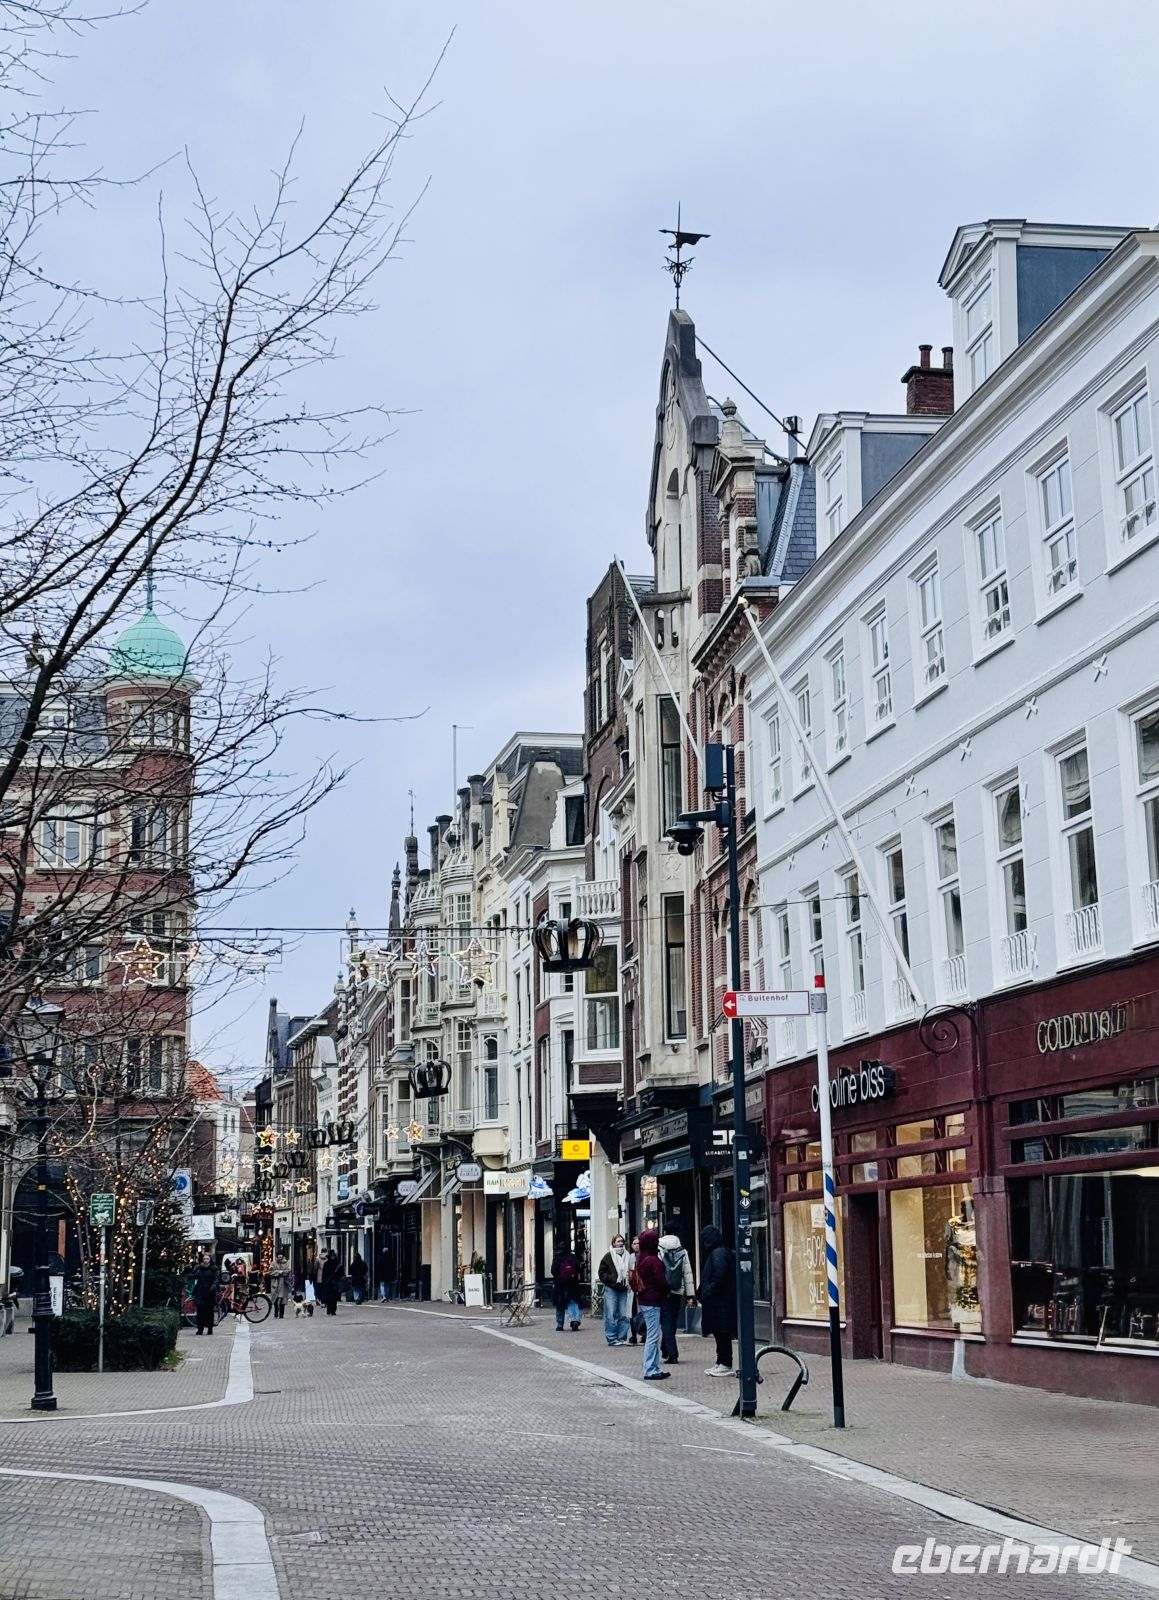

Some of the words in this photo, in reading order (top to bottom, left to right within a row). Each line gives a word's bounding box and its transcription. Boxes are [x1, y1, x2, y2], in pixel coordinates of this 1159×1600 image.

[747, 994, 789, 1002] Buitenhof
[811, 1066, 857, 1113] coline
[860, 1060, 885, 1101] biss
[808, 1281, 825, 1305] SALE
